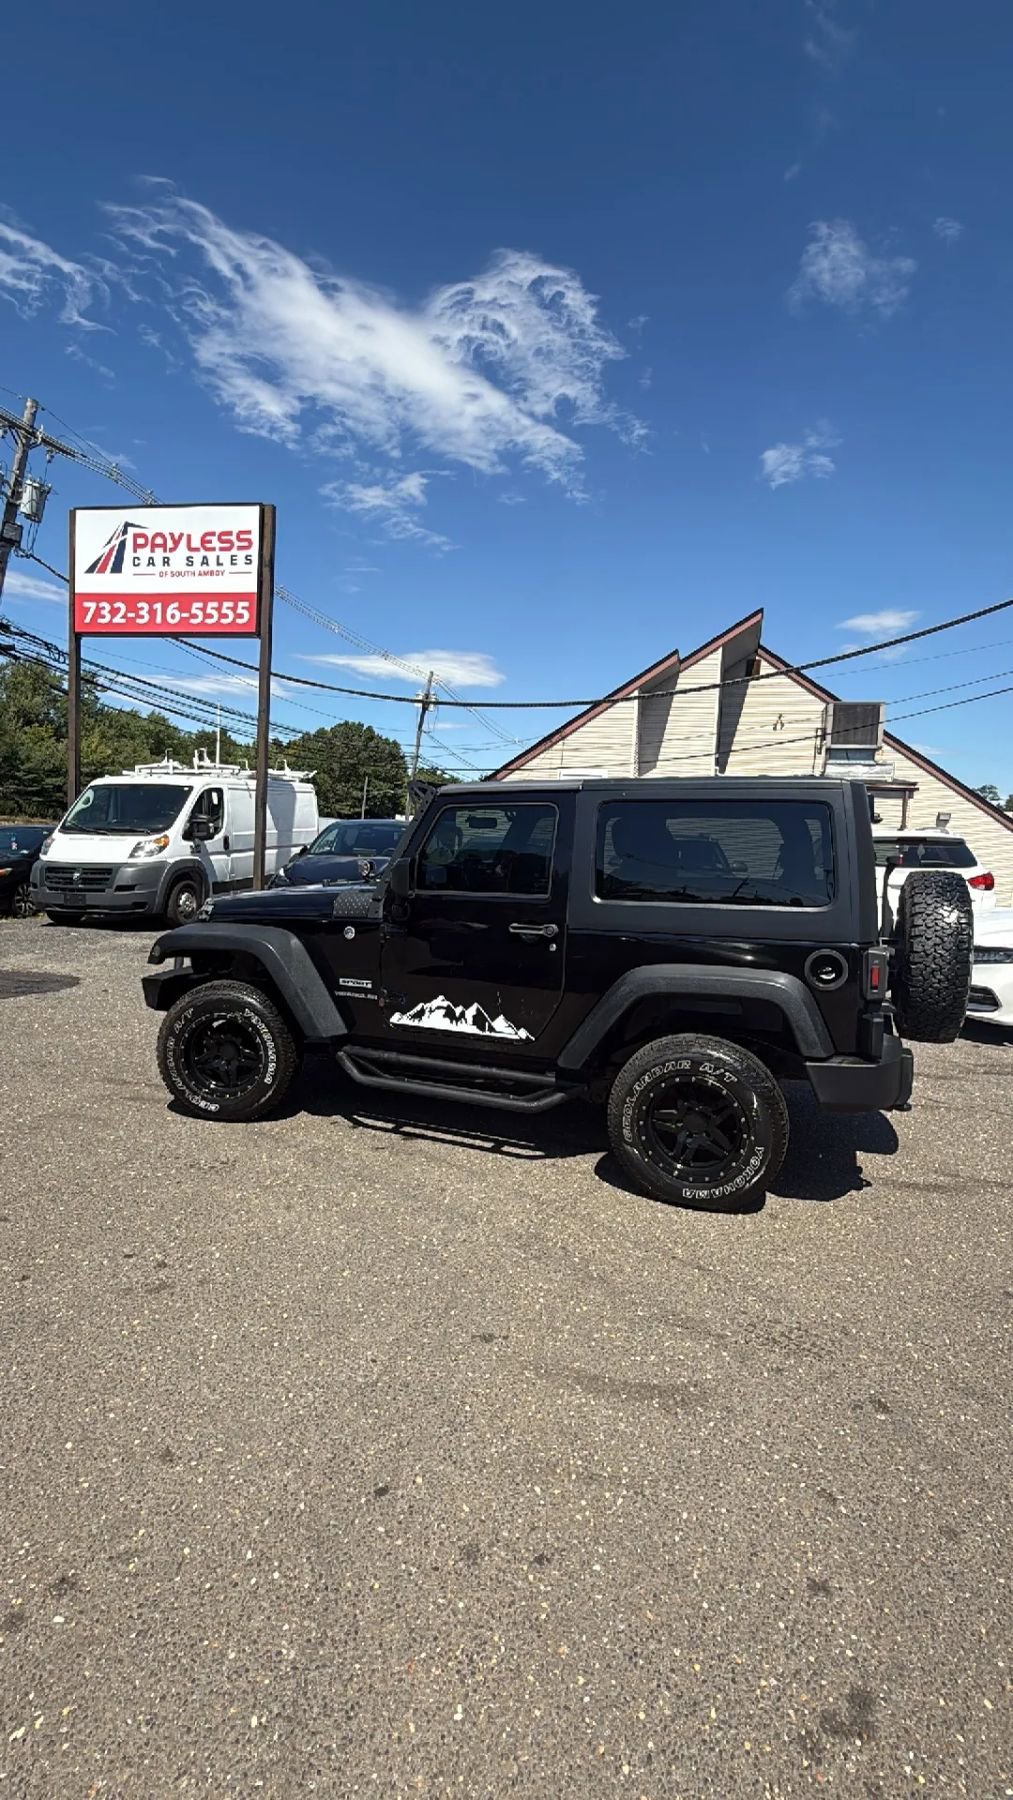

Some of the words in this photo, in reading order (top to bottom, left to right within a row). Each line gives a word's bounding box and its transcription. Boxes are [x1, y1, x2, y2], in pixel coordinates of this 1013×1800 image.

[133, 530, 254, 553] PAYLESS
[133, 556, 171, 567] CAR
[186, 555, 253, 567] SALES
[198, 569, 226, 577] AMBOY
[82, 601, 250, 624] 732-316-5555
[622, 1060, 691, 1142] GEOLANDAR
[699, 1062, 738, 1083] A/T
[682, 1146, 765, 1199] YOKOHAMA
